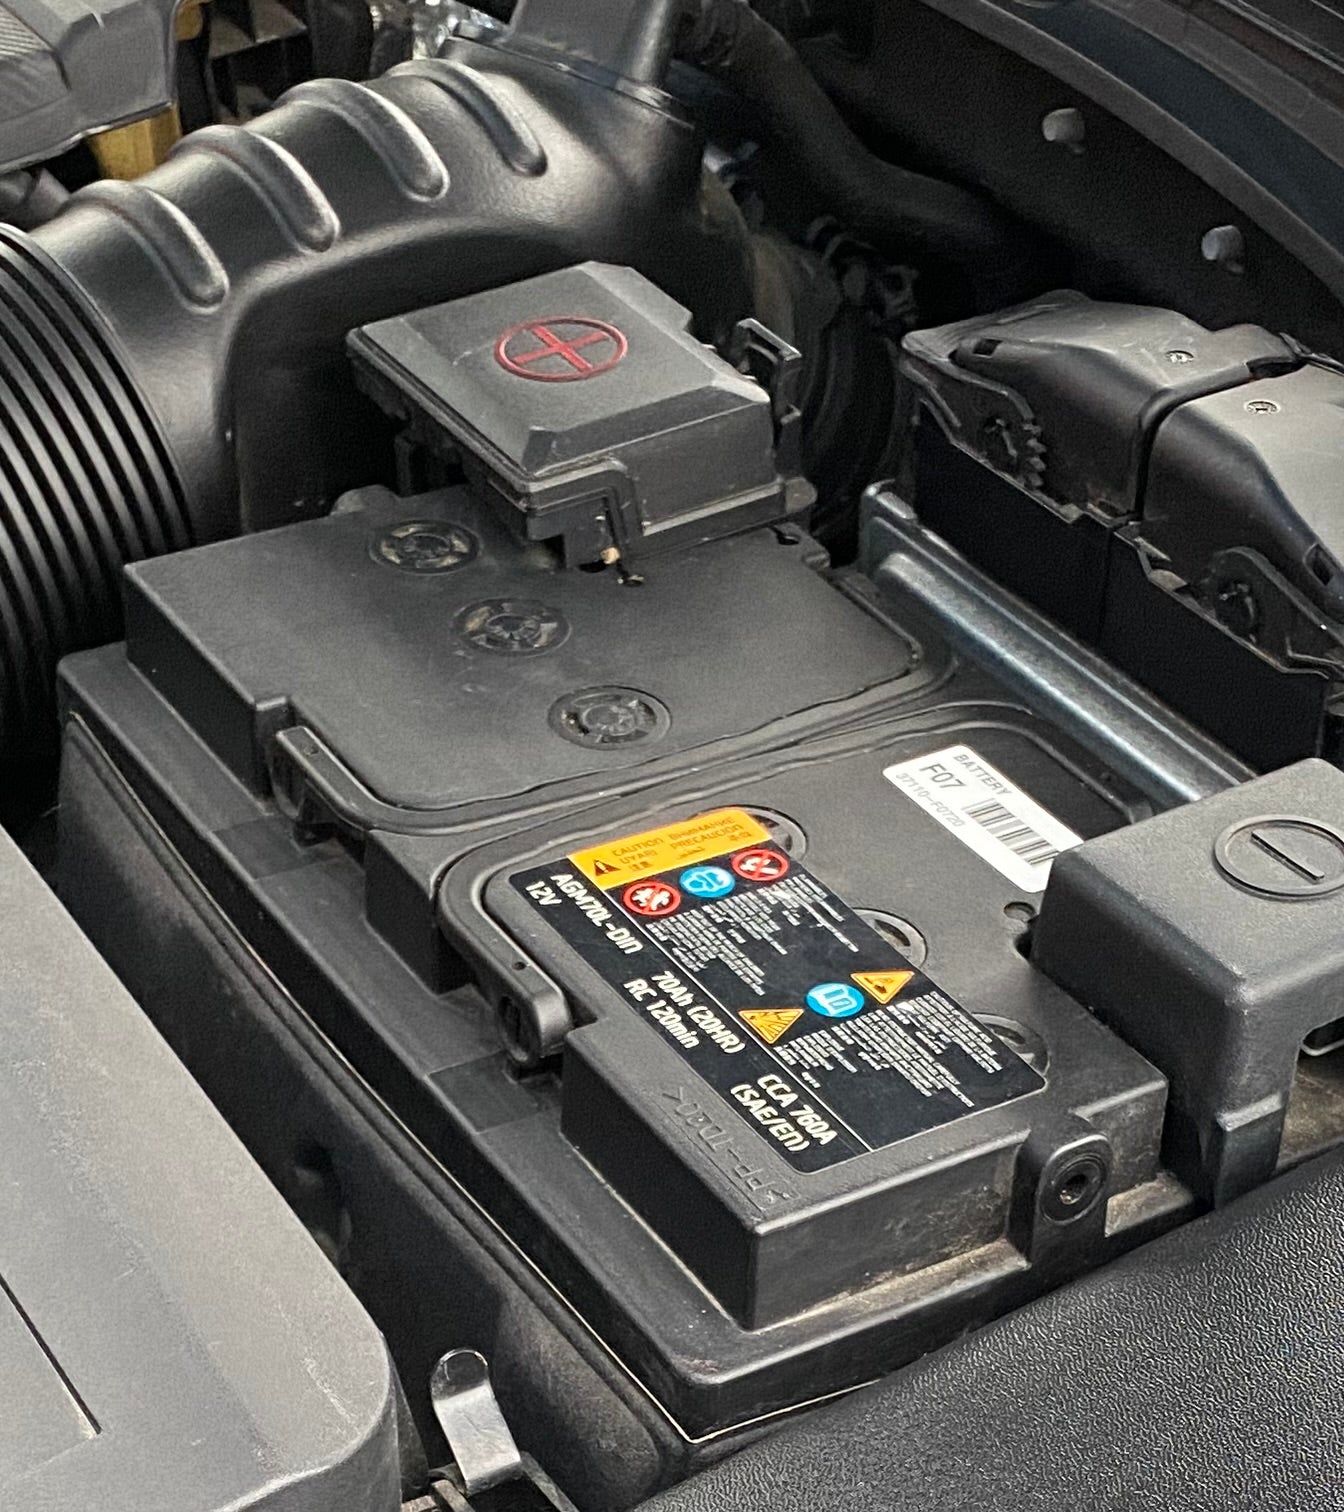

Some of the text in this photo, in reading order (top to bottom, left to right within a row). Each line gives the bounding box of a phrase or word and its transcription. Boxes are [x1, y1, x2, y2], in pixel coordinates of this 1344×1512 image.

[919, 763, 968, 789] F07
[953, 754, 1013, 795] BATTERY
[612, 837, 665, 857] CAUTION
[525, 881, 562, 907] 12V
[623, 978, 701, 1049] RC 120min
[651, 970, 746, 1054] 70Ah (20HR)
[757, 1073, 838, 1146] CCA 760A
